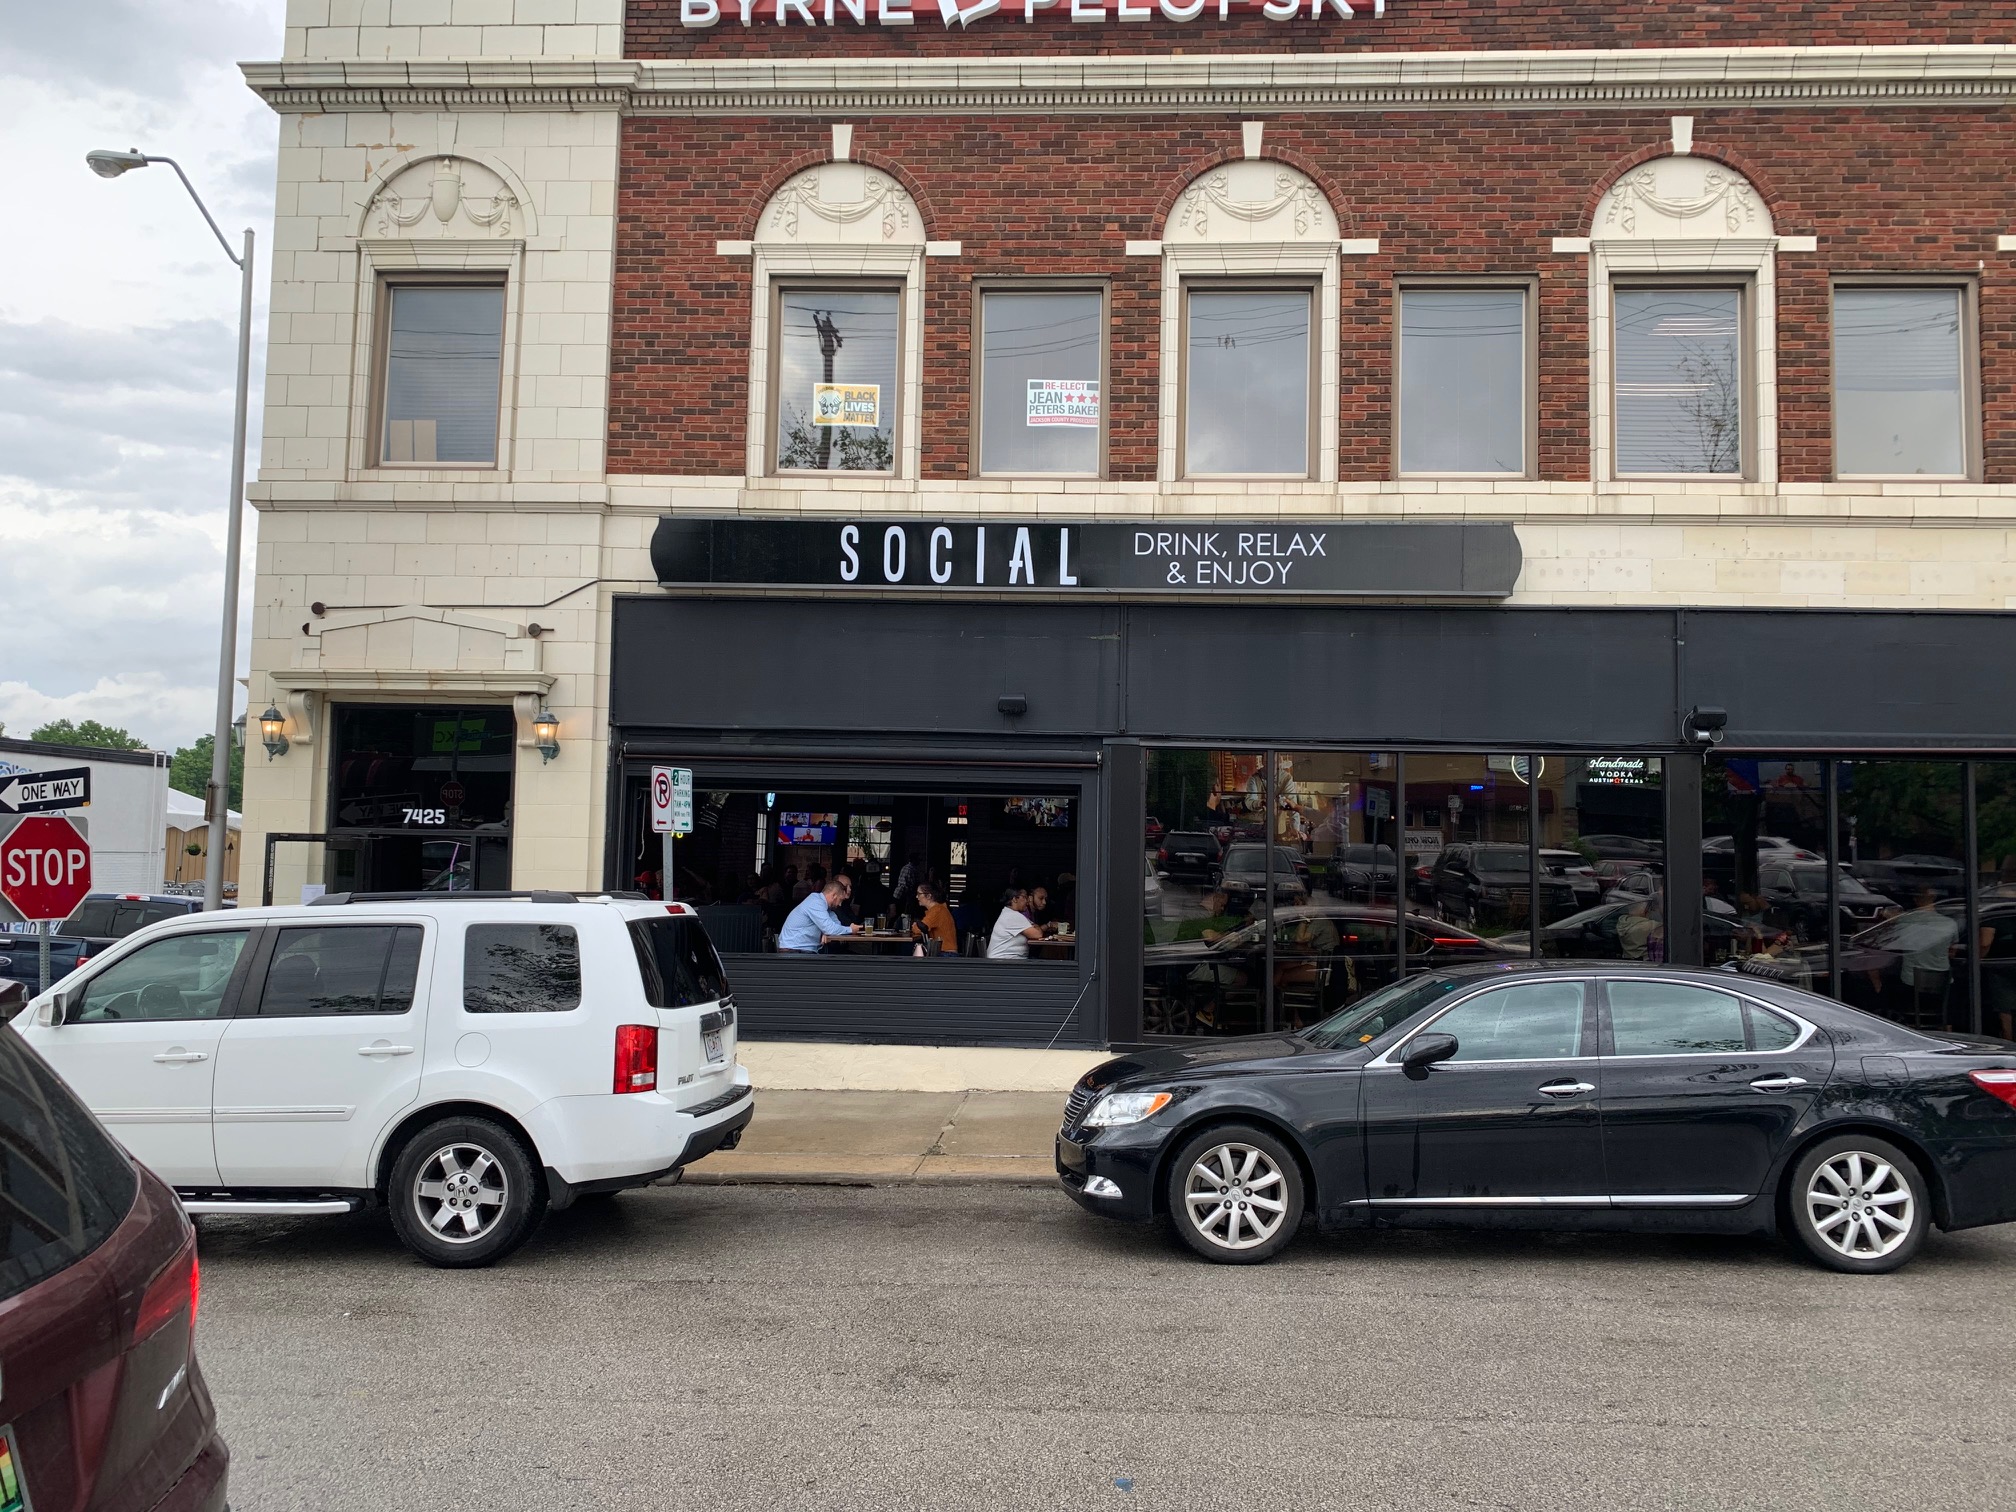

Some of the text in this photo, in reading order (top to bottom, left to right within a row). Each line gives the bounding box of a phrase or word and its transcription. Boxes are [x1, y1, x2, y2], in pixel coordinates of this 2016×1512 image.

[1045, 382, 1086, 390] RE-ELECT
[845, 391, 876, 400] BLACK
[1030, 392, 1063, 404] JEAN
[845, 402, 875, 412] LIVES
[1029, 405, 1065, 414] PETERS
[843, 413, 875, 423] MATTER
[1134, 532, 1326, 558] DRINK, RELAX
[840, 525, 1078, 585] SOCIAL
[1166, 561, 1293, 584] & ENJOY
[1589, 757, 1644, 768] Handmade
[21, 780, 80, 801] ONE WAY
[402, 809, 445, 824] 7425
[6, 848, 86, 887] STOP
[677, 1073, 694, 1086] PILOT
